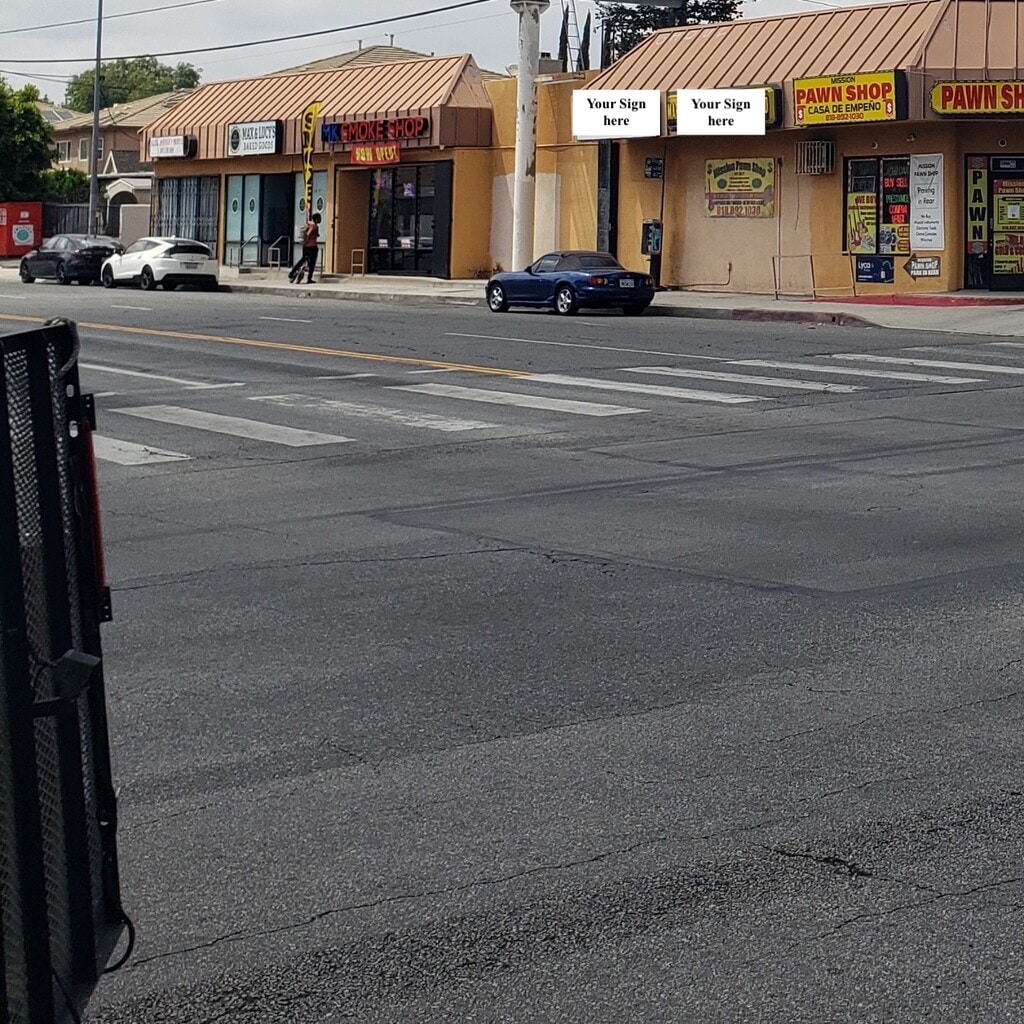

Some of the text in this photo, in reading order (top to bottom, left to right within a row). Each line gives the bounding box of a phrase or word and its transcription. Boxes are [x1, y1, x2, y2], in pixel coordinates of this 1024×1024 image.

[796, 82, 892, 104] PAWN SHOP
[942, 85, 997, 110] PAWN
[808, 101, 881, 114] CASA DE EMPEÑO
[323, 117, 424, 141] MK SMOKE SHOP
[243, 140, 273, 150] BAKED GOODS
[356, 148, 373, 161] NOW
[969, 170, 986, 240] PAWN
